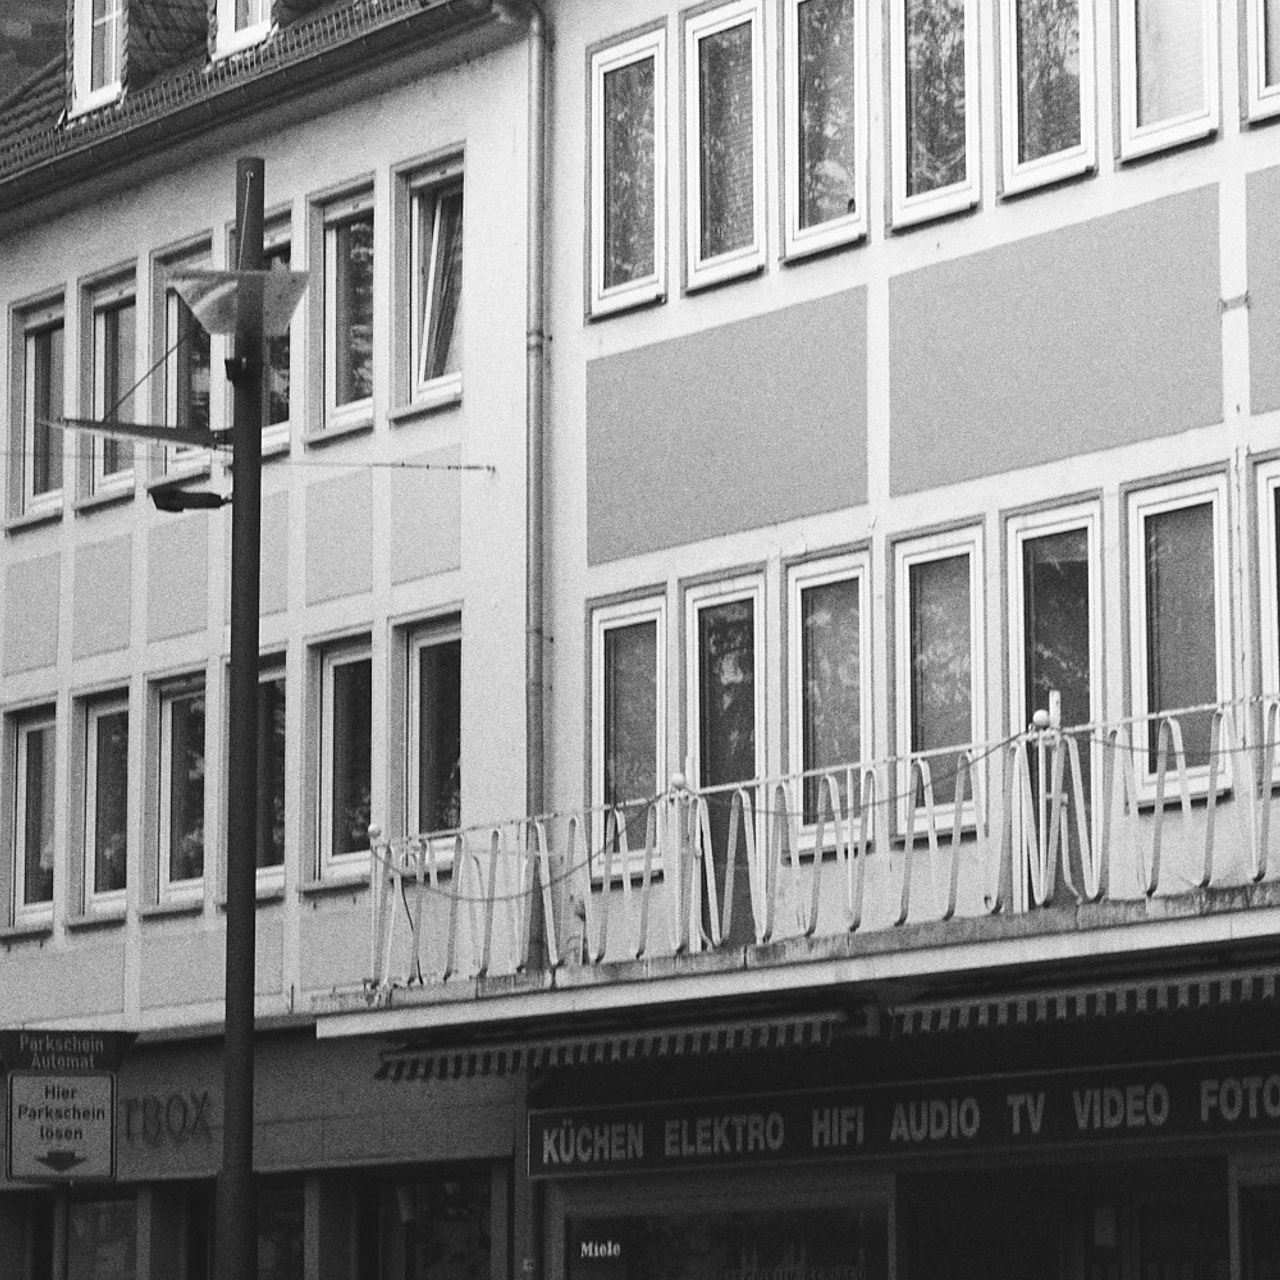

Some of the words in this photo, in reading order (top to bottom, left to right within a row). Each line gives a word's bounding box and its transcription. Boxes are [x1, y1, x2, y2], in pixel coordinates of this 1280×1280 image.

[19, 1033, 105, 1053] Parkschein
[30, 1053, 95, 1070] Automat
[43, 1084, 78, 1100] Hier
[17, 1104, 106, 1121] Parkschein
[541, 1117, 644, 1165] KÜCHEN
[664, 1112, 785, 1157] ELEKTRO
[811, 1106, 865, 1147] HIFI
[890, 1097, 981, 1143] AUDIO
[1007, 1092, 1046, 1134] TV
[1072, 1083, 1170, 1129] VIDEO
[39, 1125, 84, 1141] lösen
[579, 1240, 622, 1259] Miele
